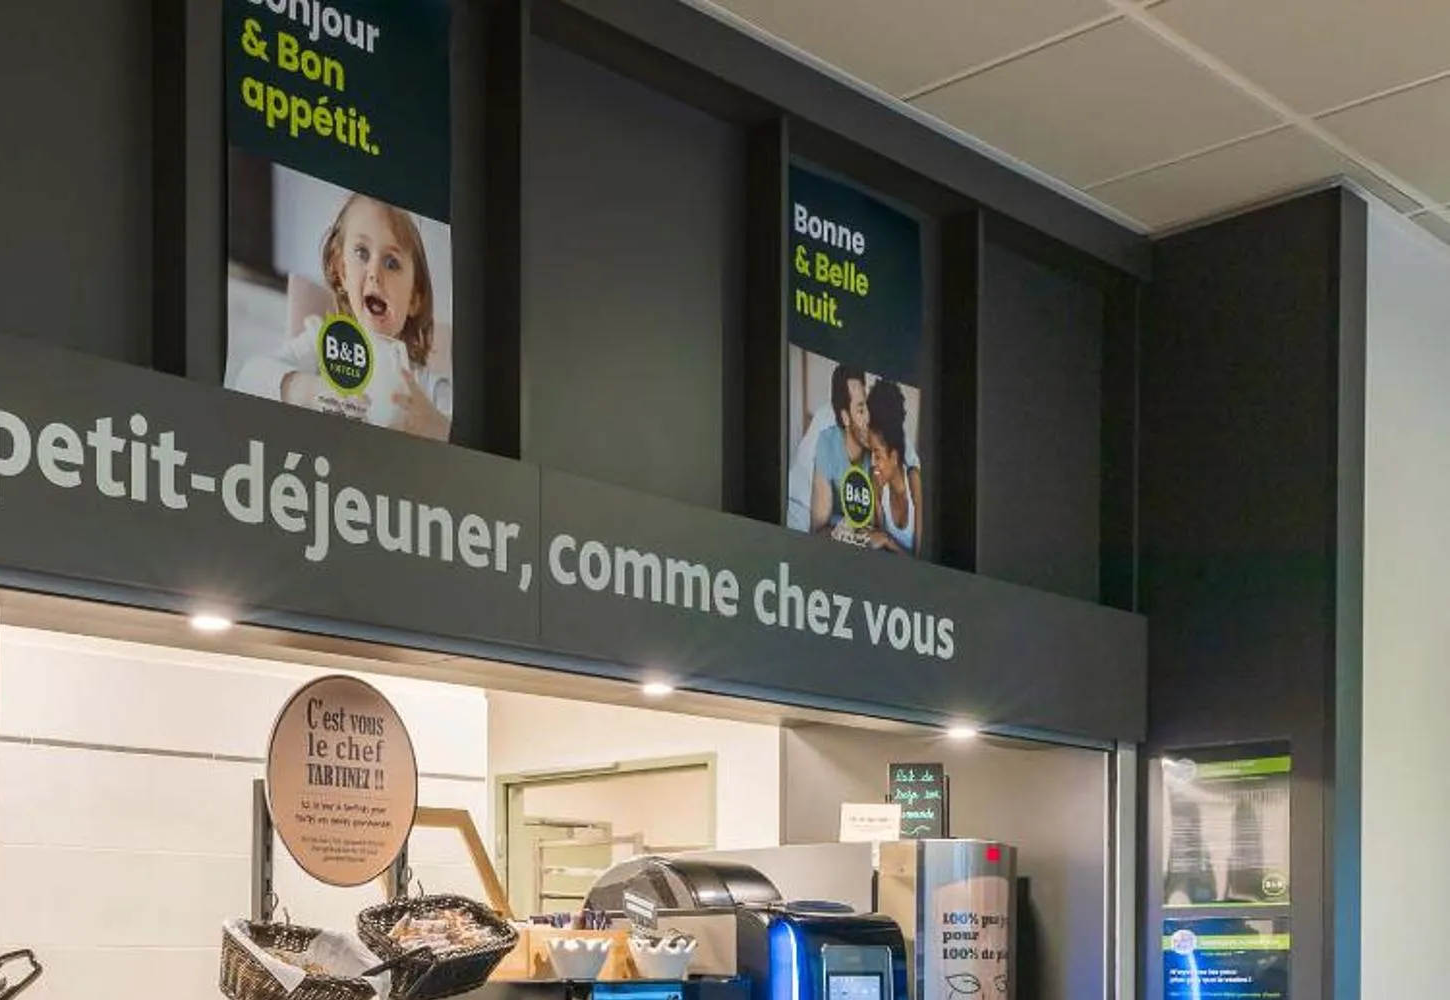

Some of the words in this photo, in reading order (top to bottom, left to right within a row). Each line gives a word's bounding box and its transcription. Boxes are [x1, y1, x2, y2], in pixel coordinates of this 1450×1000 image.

[248, 0, 380, 53] njour
[242, 18, 270, 62] &
[278, 31, 345, 92] Bon
[242, 76, 380, 155] appétit.
[794, 202, 865, 255] Bonne
[796, 245, 810, 277] &
[815, 252, 869, 296] Belle
[796, 289, 843, 328] nuit.
[326, 335, 367, 368] B&B
[550, 533, 739, 617] comme
[754, 562, 853, 640] chez
[863, 600, 955, 660] vous
[307, 697, 345, 732] C'est
[350, 713, 384, 737] vous
[308, 732, 328, 758] le
[336, 736, 385, 762] chef
[307, 763, 370, 789] TARTINEZ
[943, 912, 979, 925] 100%
[943, 931, 979, 944] pour
[943, 947, 979, 960] 100%
